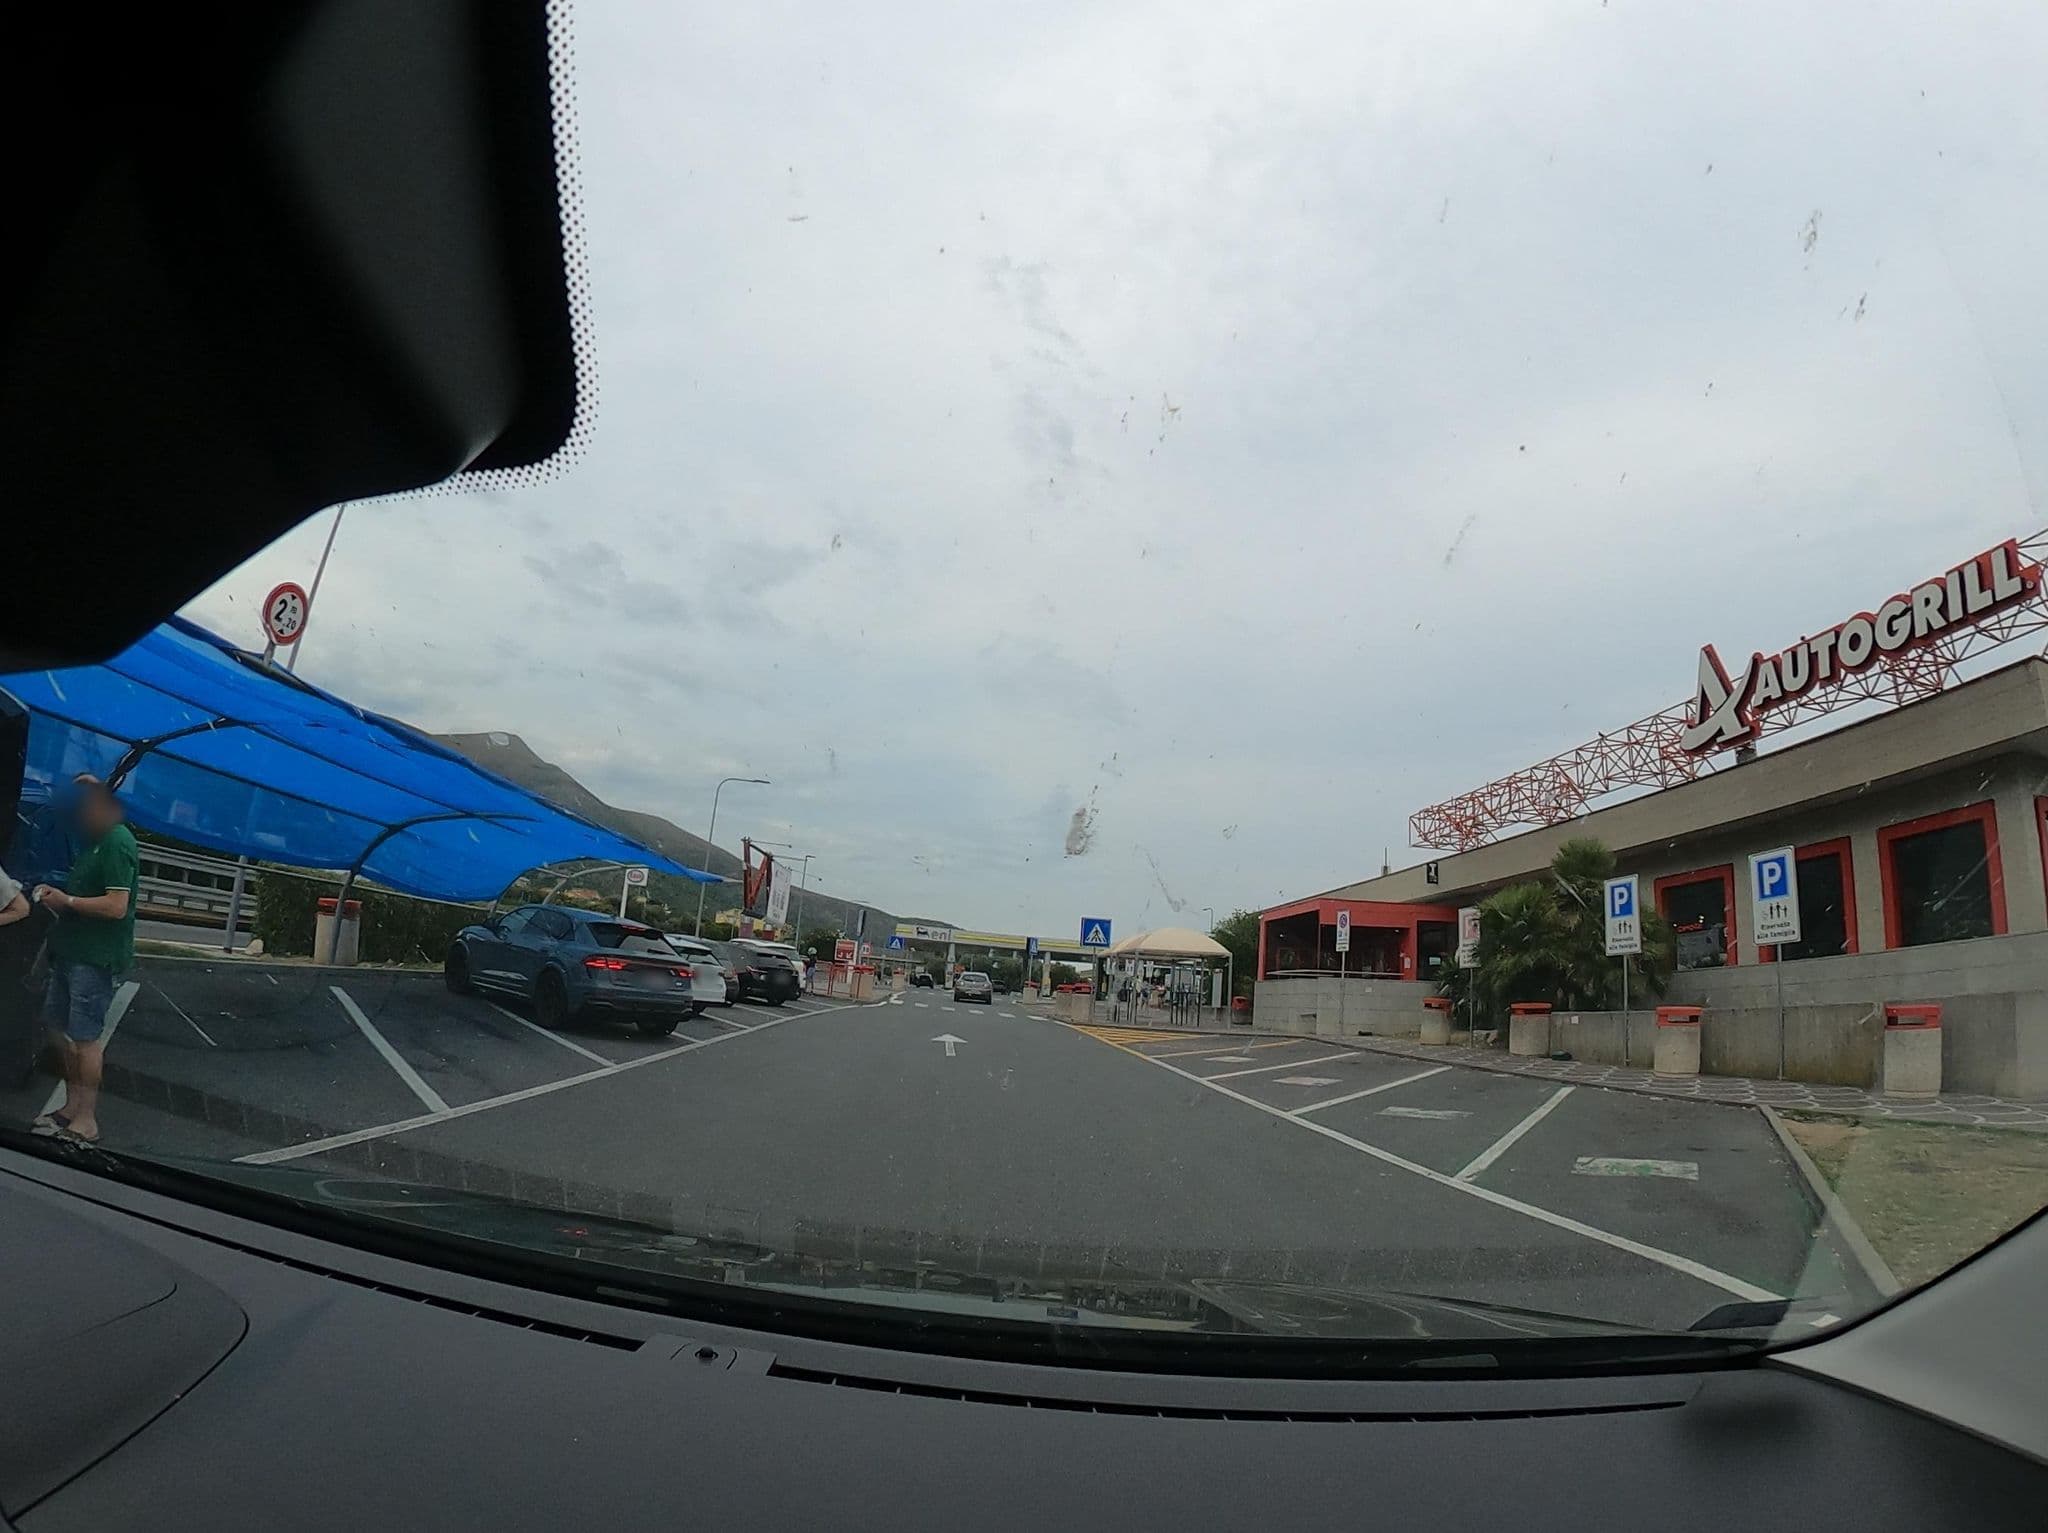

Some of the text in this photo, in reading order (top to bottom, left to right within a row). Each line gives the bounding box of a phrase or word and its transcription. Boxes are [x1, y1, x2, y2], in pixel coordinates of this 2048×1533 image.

[1752, 547, 2022, 706] AUTOGRILL
[1763, 861, 1782, 896] P
[1613, 886, 1629, 915] P
